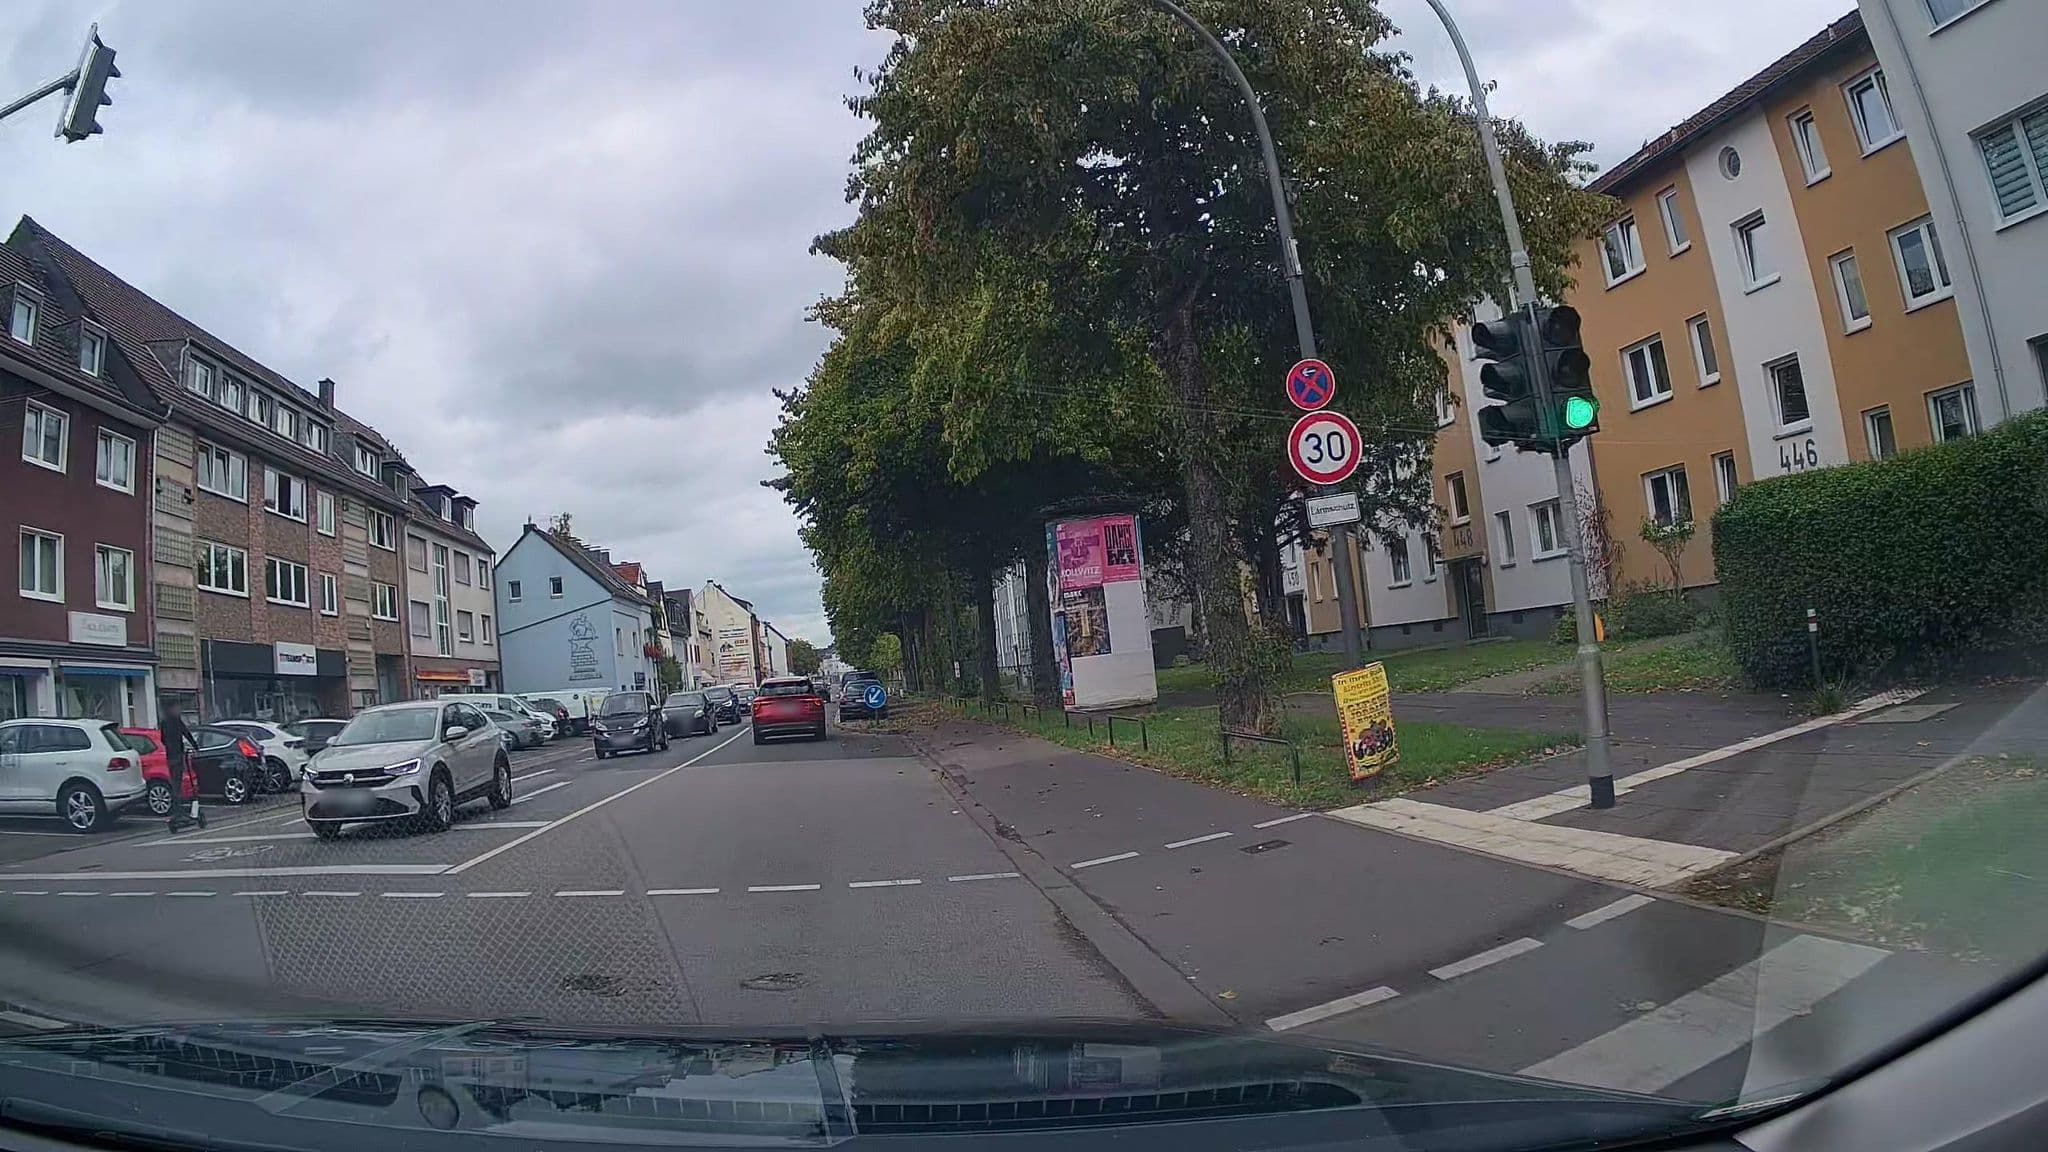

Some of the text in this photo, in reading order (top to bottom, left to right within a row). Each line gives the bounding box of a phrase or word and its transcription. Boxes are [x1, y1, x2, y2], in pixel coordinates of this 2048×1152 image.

[1304, 431, 1346, 464] 30
[1779, 438, 1818, 472] 446
[1453, 528, 1473, 550] 448
